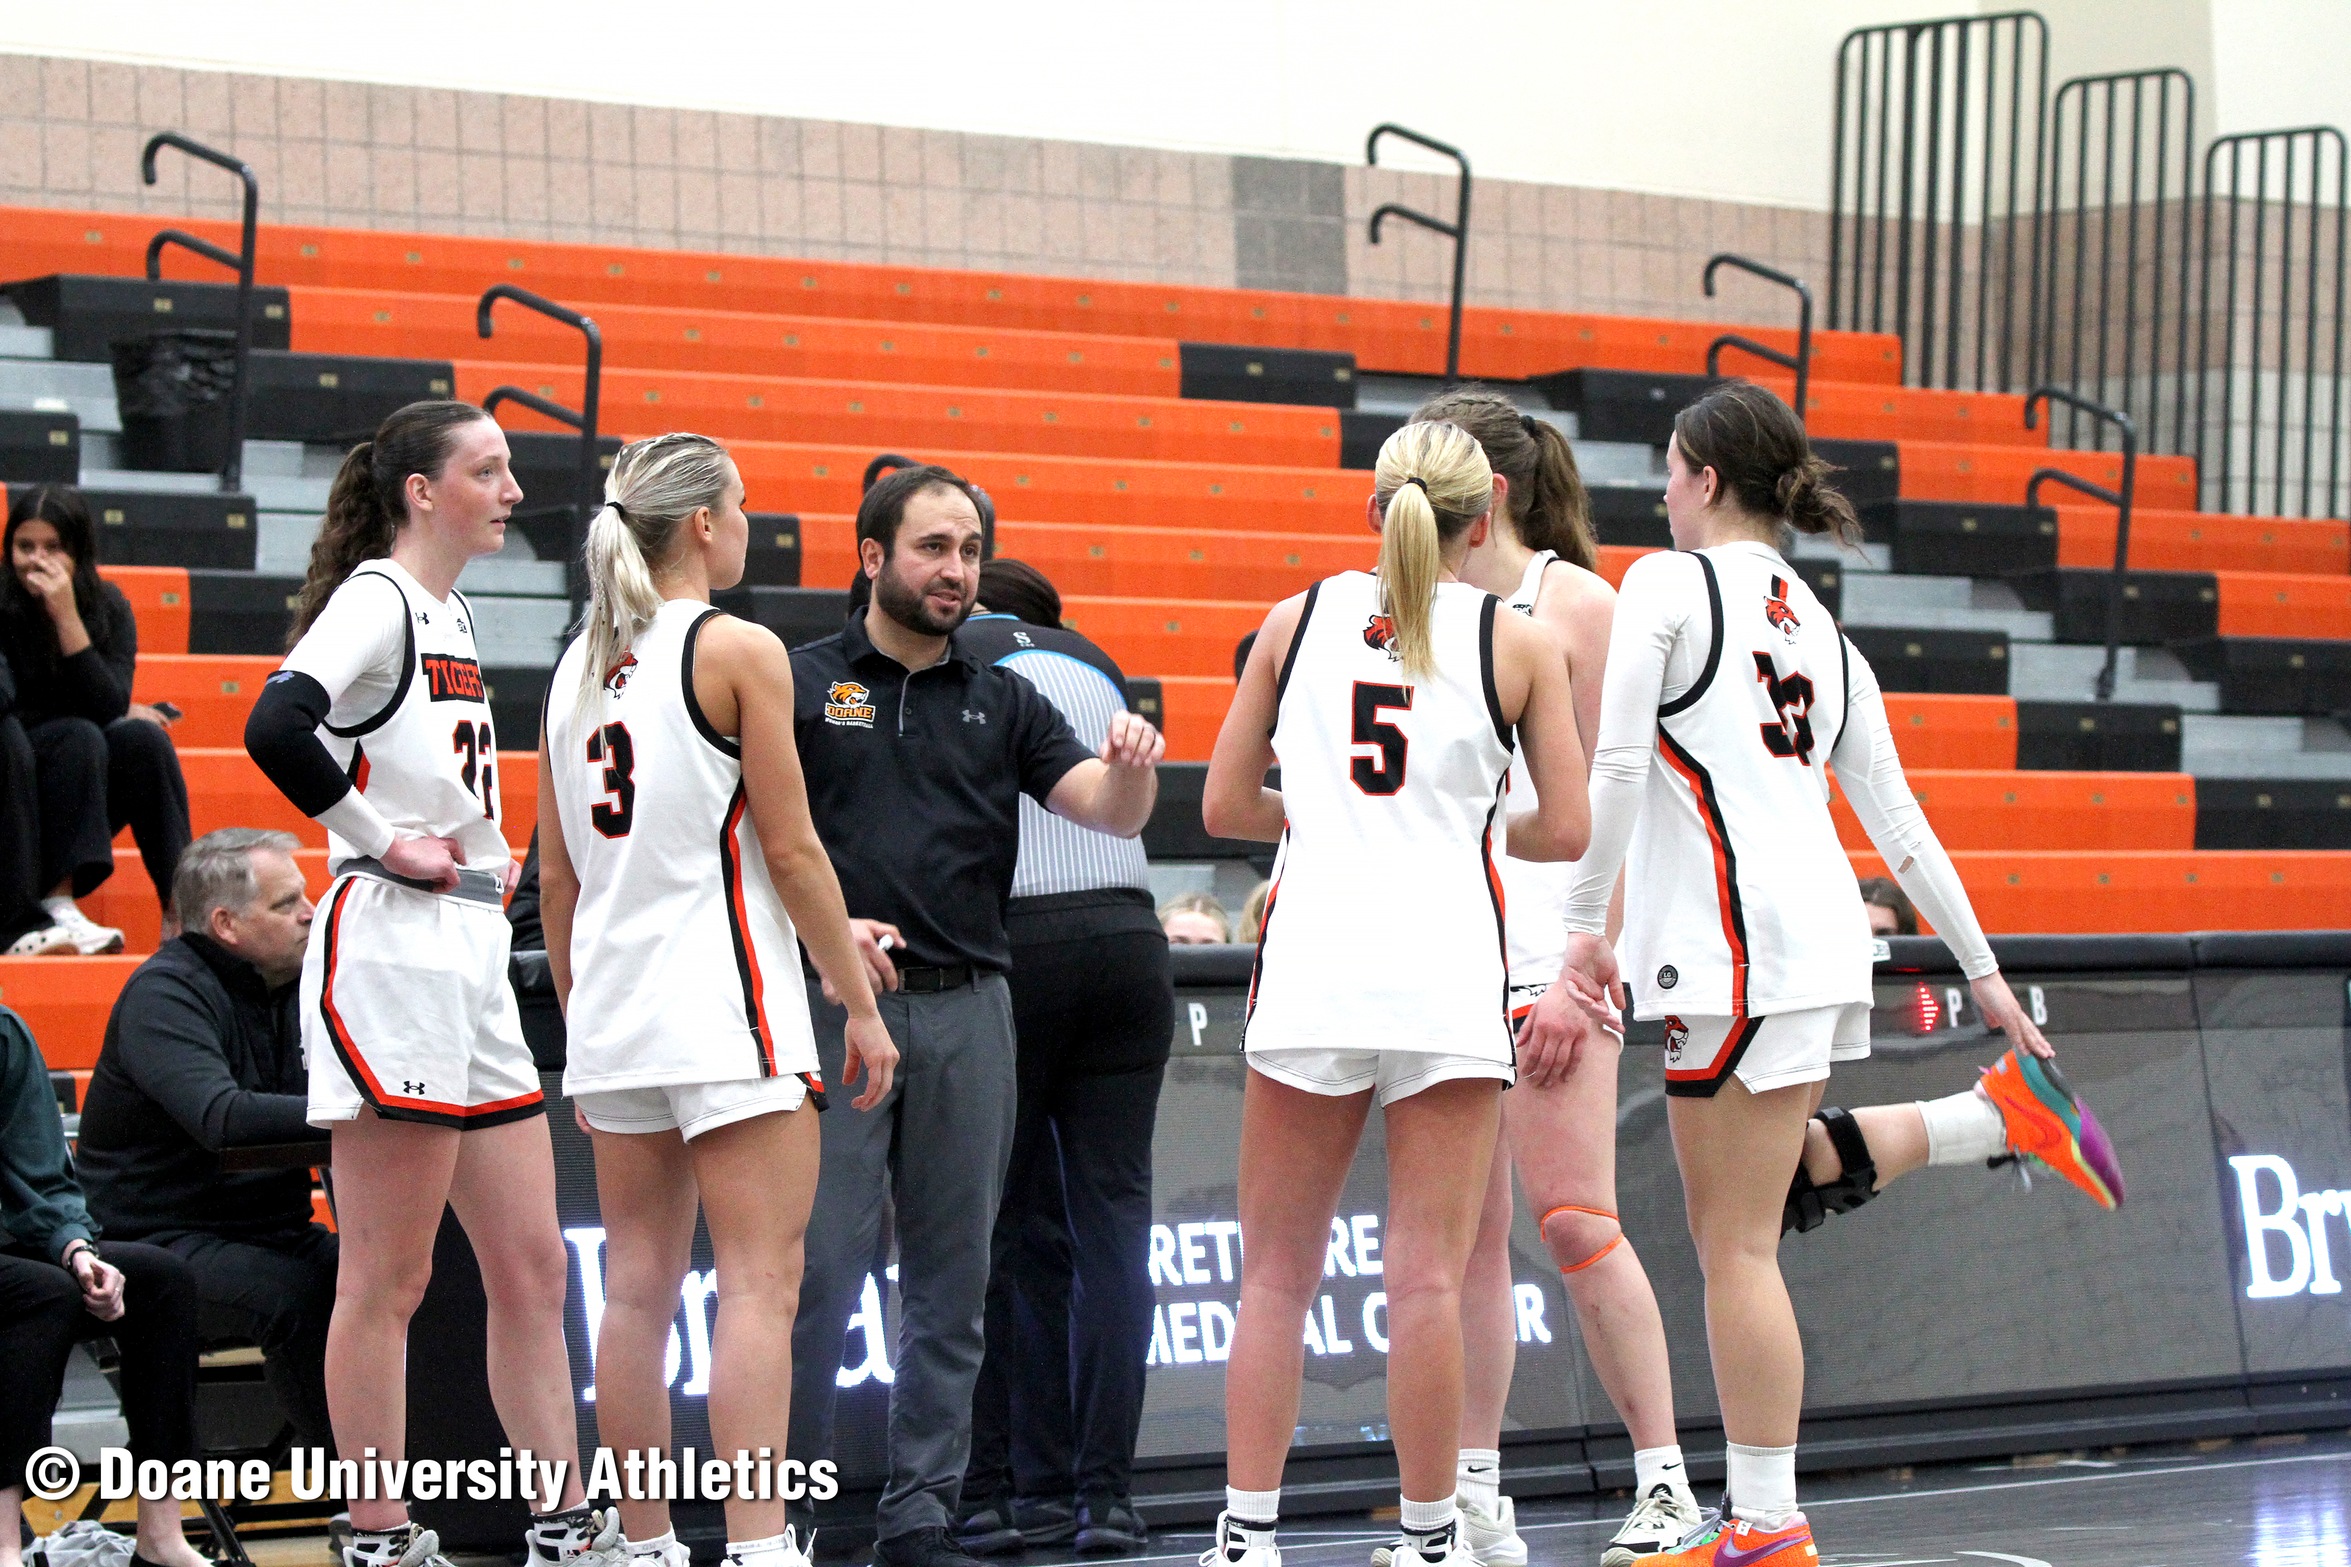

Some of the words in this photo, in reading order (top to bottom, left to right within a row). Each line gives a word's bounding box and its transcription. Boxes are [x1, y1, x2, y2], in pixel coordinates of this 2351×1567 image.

[827, 705, 873, 719] DOANE
[1350, 680, 1414, 796] 5
[586, 721, 635, 839] 3
[1188, 1002, 1208, 1046] P
[1946, 987, 1963, 1028] P
[2029, 985, 2048, 1026] B
[2229, 1154, 2351, 1298] Br
